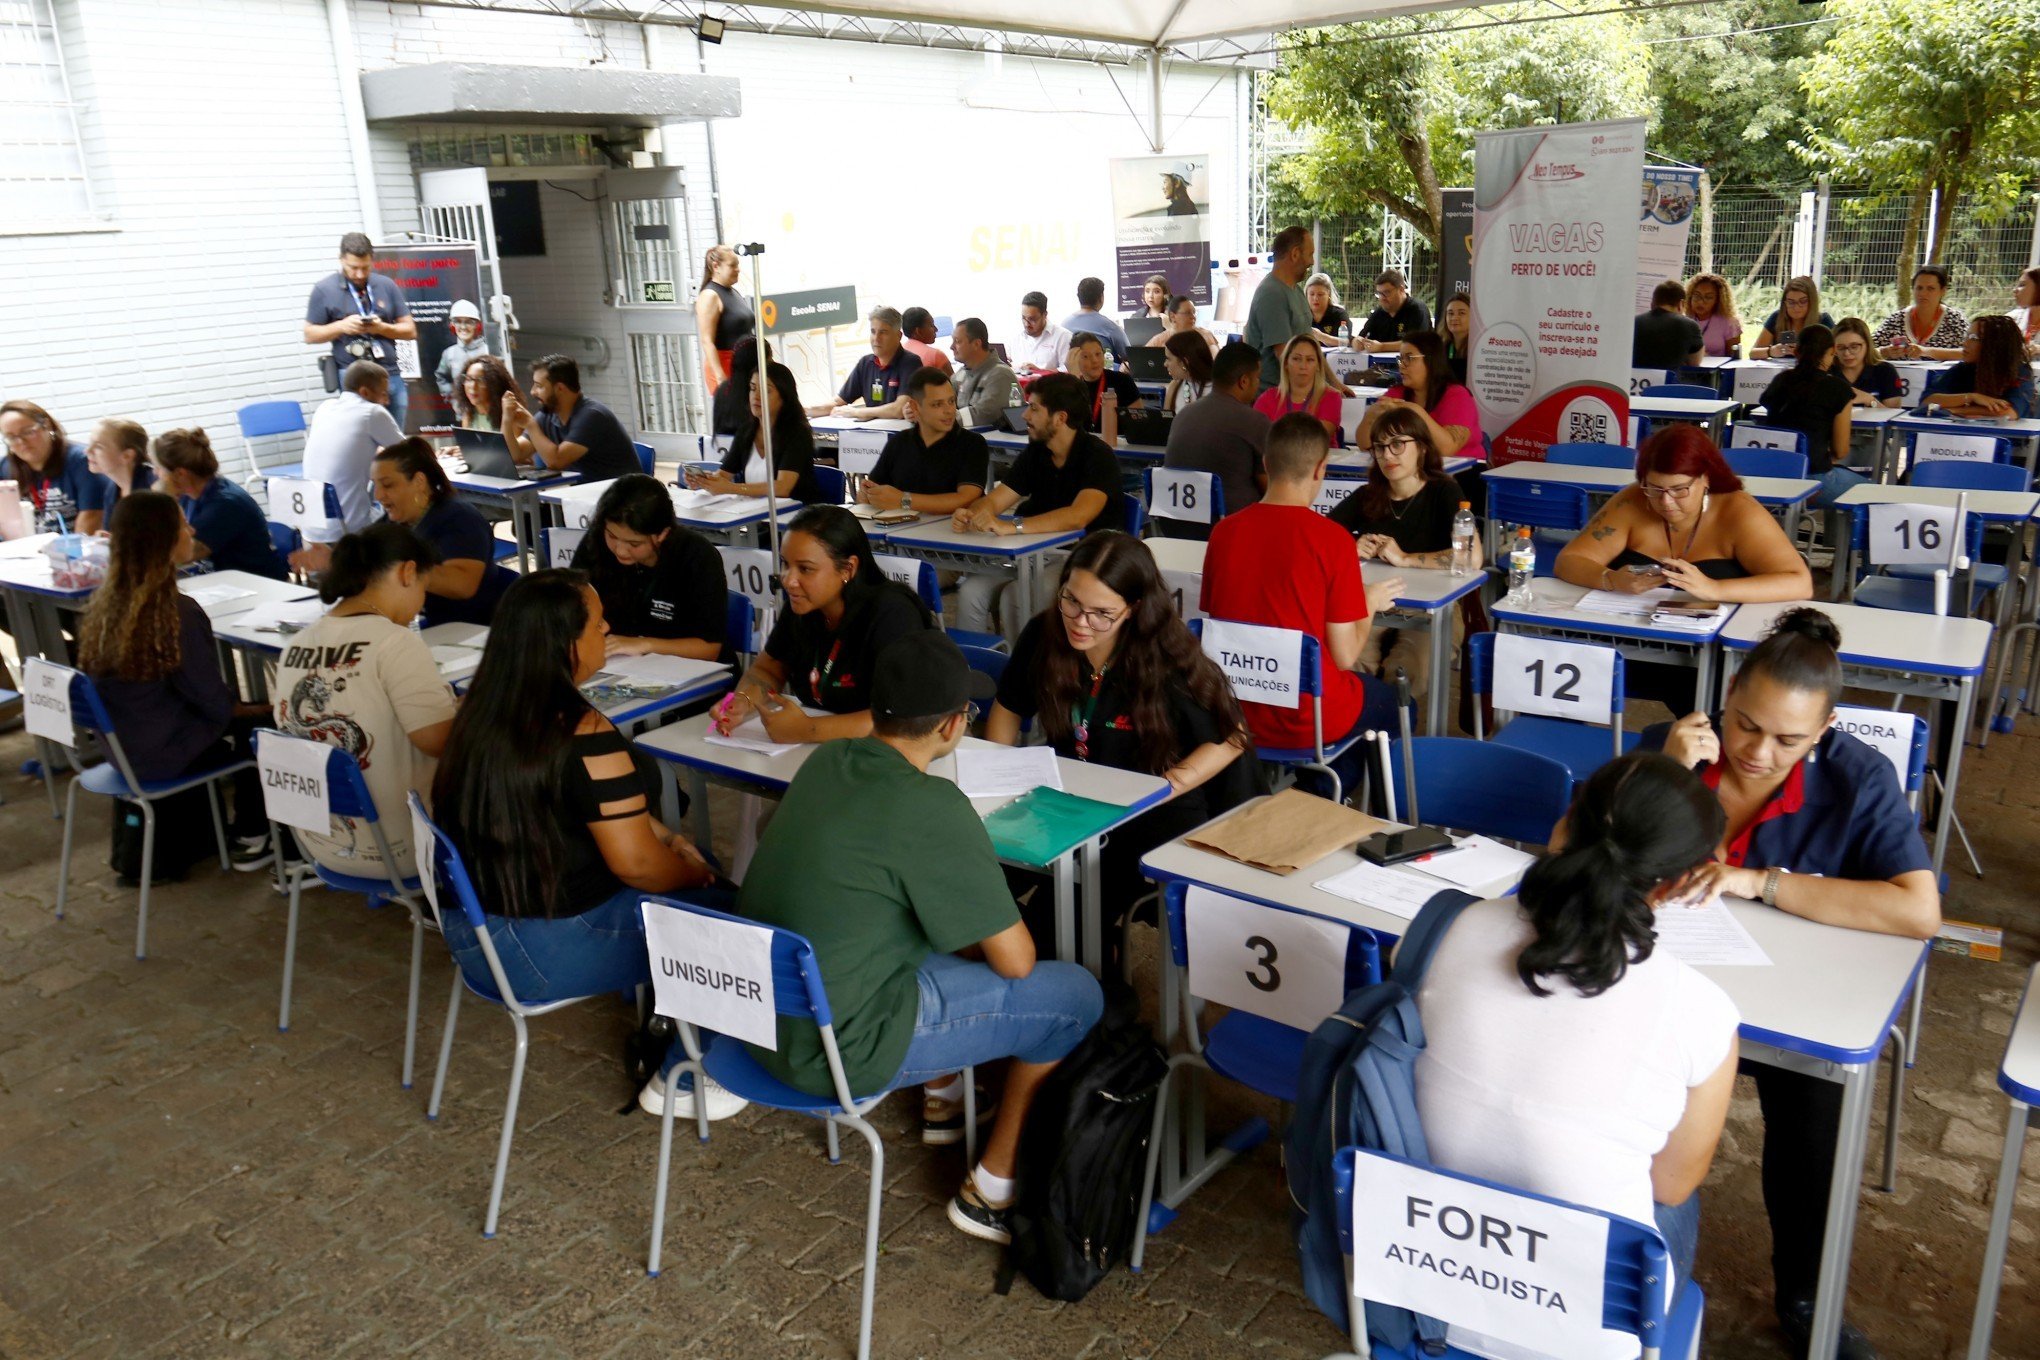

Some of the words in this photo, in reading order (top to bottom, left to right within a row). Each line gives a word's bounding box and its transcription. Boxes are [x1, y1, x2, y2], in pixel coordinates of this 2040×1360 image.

[1534, 163, 1547, 176] Neo
[1549, 162, 1576, 176] Tempus
[1508, 222, 1604, 253] VAGAS
[968, 221, 1081, 272] SENAI
[430, 257, 459, 270] parte
[1511, 263, 1543, 275] PERTO
[1546, 264, 1560, 275] DE
[1563, 260, 1596, 277] VOCÊ!
[1454, 281, 1470, 293] RH
[791, 305, 816, 316] Escola
[816, 301, 840, 312] SENAI
[1547, 307, 1584, 318] Cadastre
[1586, 311, 1592, 319] o
[1538, 321, 1553, 329] seu
[1488, 337, 1522, 347] #souneo
[1539, 331, 1585, 344] inscreva-se
[1587, 336, 1598, 344] na
[1538, 346, 1558, 356] vaga
[1560, 346, 1597, 358] desejada
[1740, 382, 1769, 390] MAXIFO
[1505, 436, 1524, 445] Portal
[1507, 446, 1530, 457] Acesse
[1930, 447, 1978, 458] MODULAR
[1168, 482, 1196, 509] 18
[1325, 488, 1352, 500] NEO
[292, 492, 305, 514] 8
[1894, 519, 1941, 550] 16
[557, 549, 576, 561] AT
[732, 563, 763, 595] 10
[284, 641, 371, 670] BRAVE
[1220, 651, 1279, 673] TAHTO
[1226, 675, 1290, 693] UNICAÇÕES
[1525, 659, 1581, 702] 12
[1835, 720, 1897, 739] ADORA
[265, 768, 321, 798] ZAFFARI
[1245, 935, 1281, 992] 3
[661, 956, 762, 1003] UNISUPER
[1407, 1195, 1548, 1263] FORT
[1385, 1243, 1567, 1314] ATACADISTA
